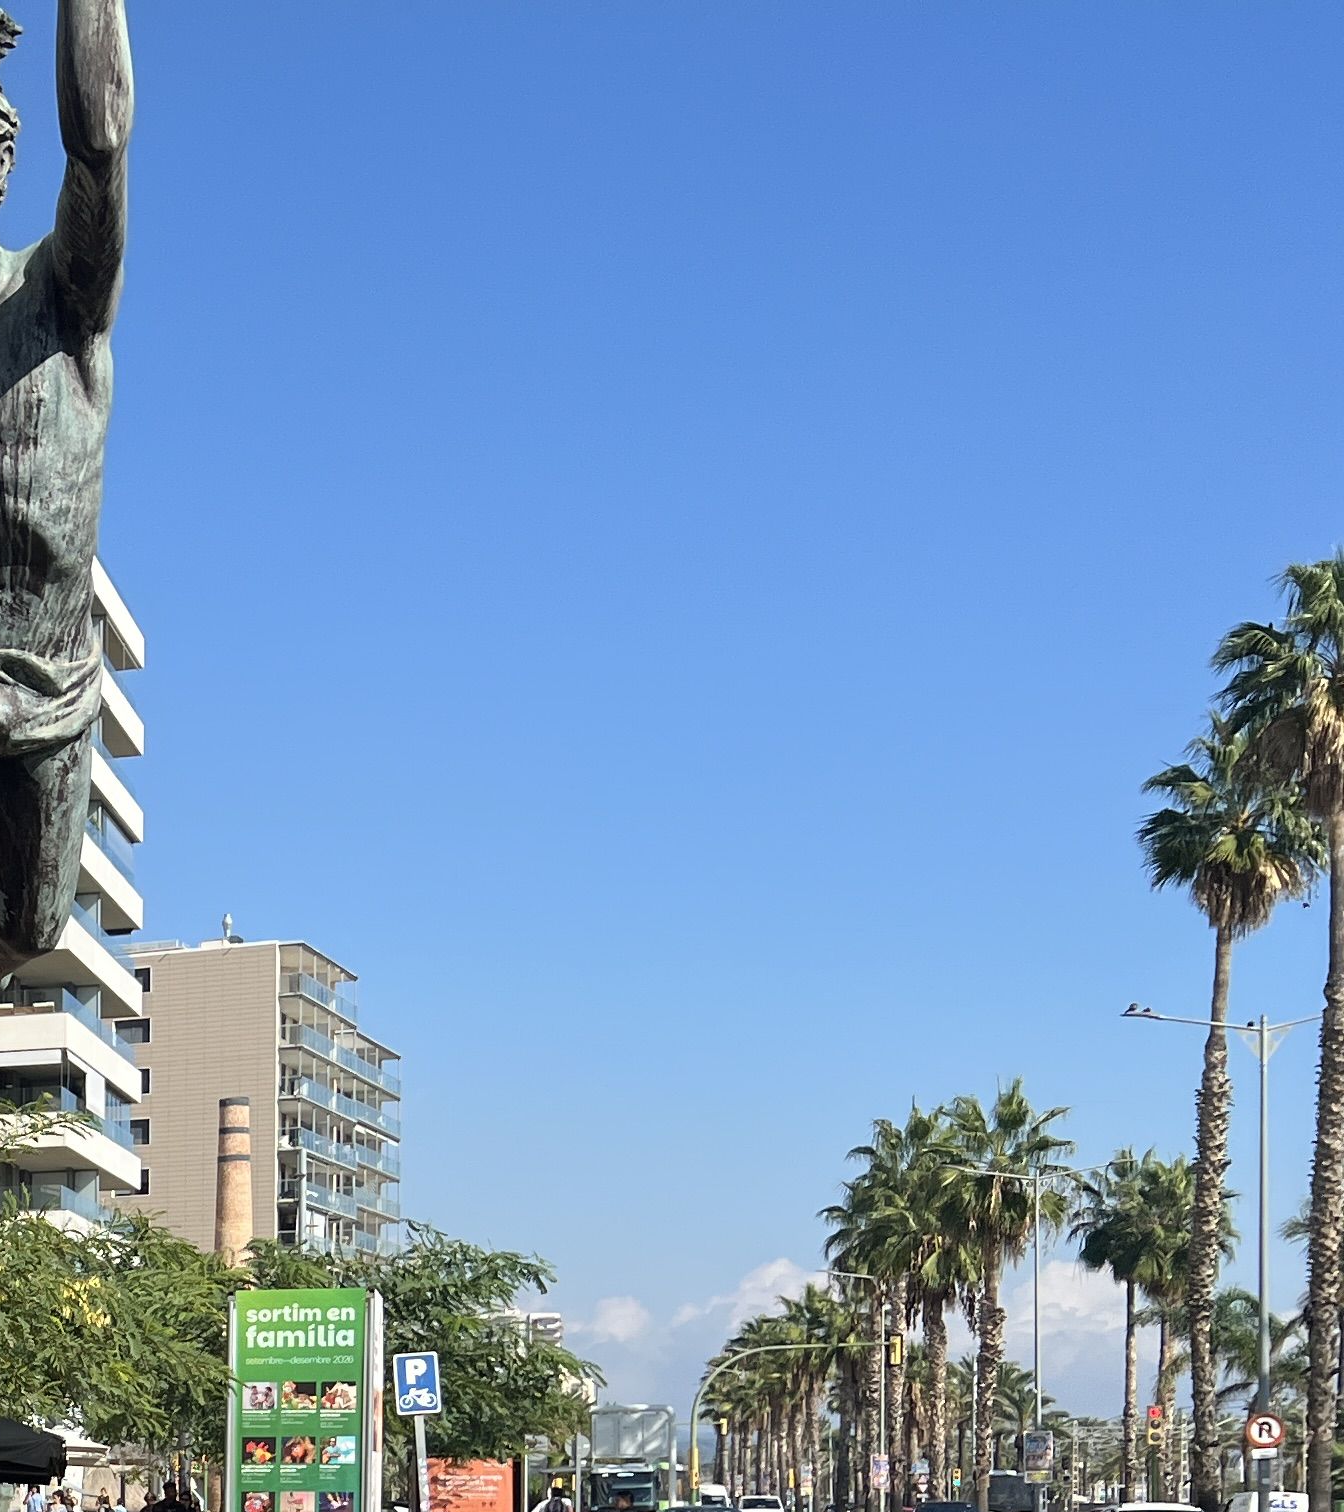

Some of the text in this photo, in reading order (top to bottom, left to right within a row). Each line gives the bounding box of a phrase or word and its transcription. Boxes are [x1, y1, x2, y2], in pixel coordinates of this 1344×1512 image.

[246, 1303, 356, 1323] sortim en
[246, 1323, 355, 1348] família
[405, 1358, 427, 1385] P
[1269, 1499, 1298, 1510] GLS
